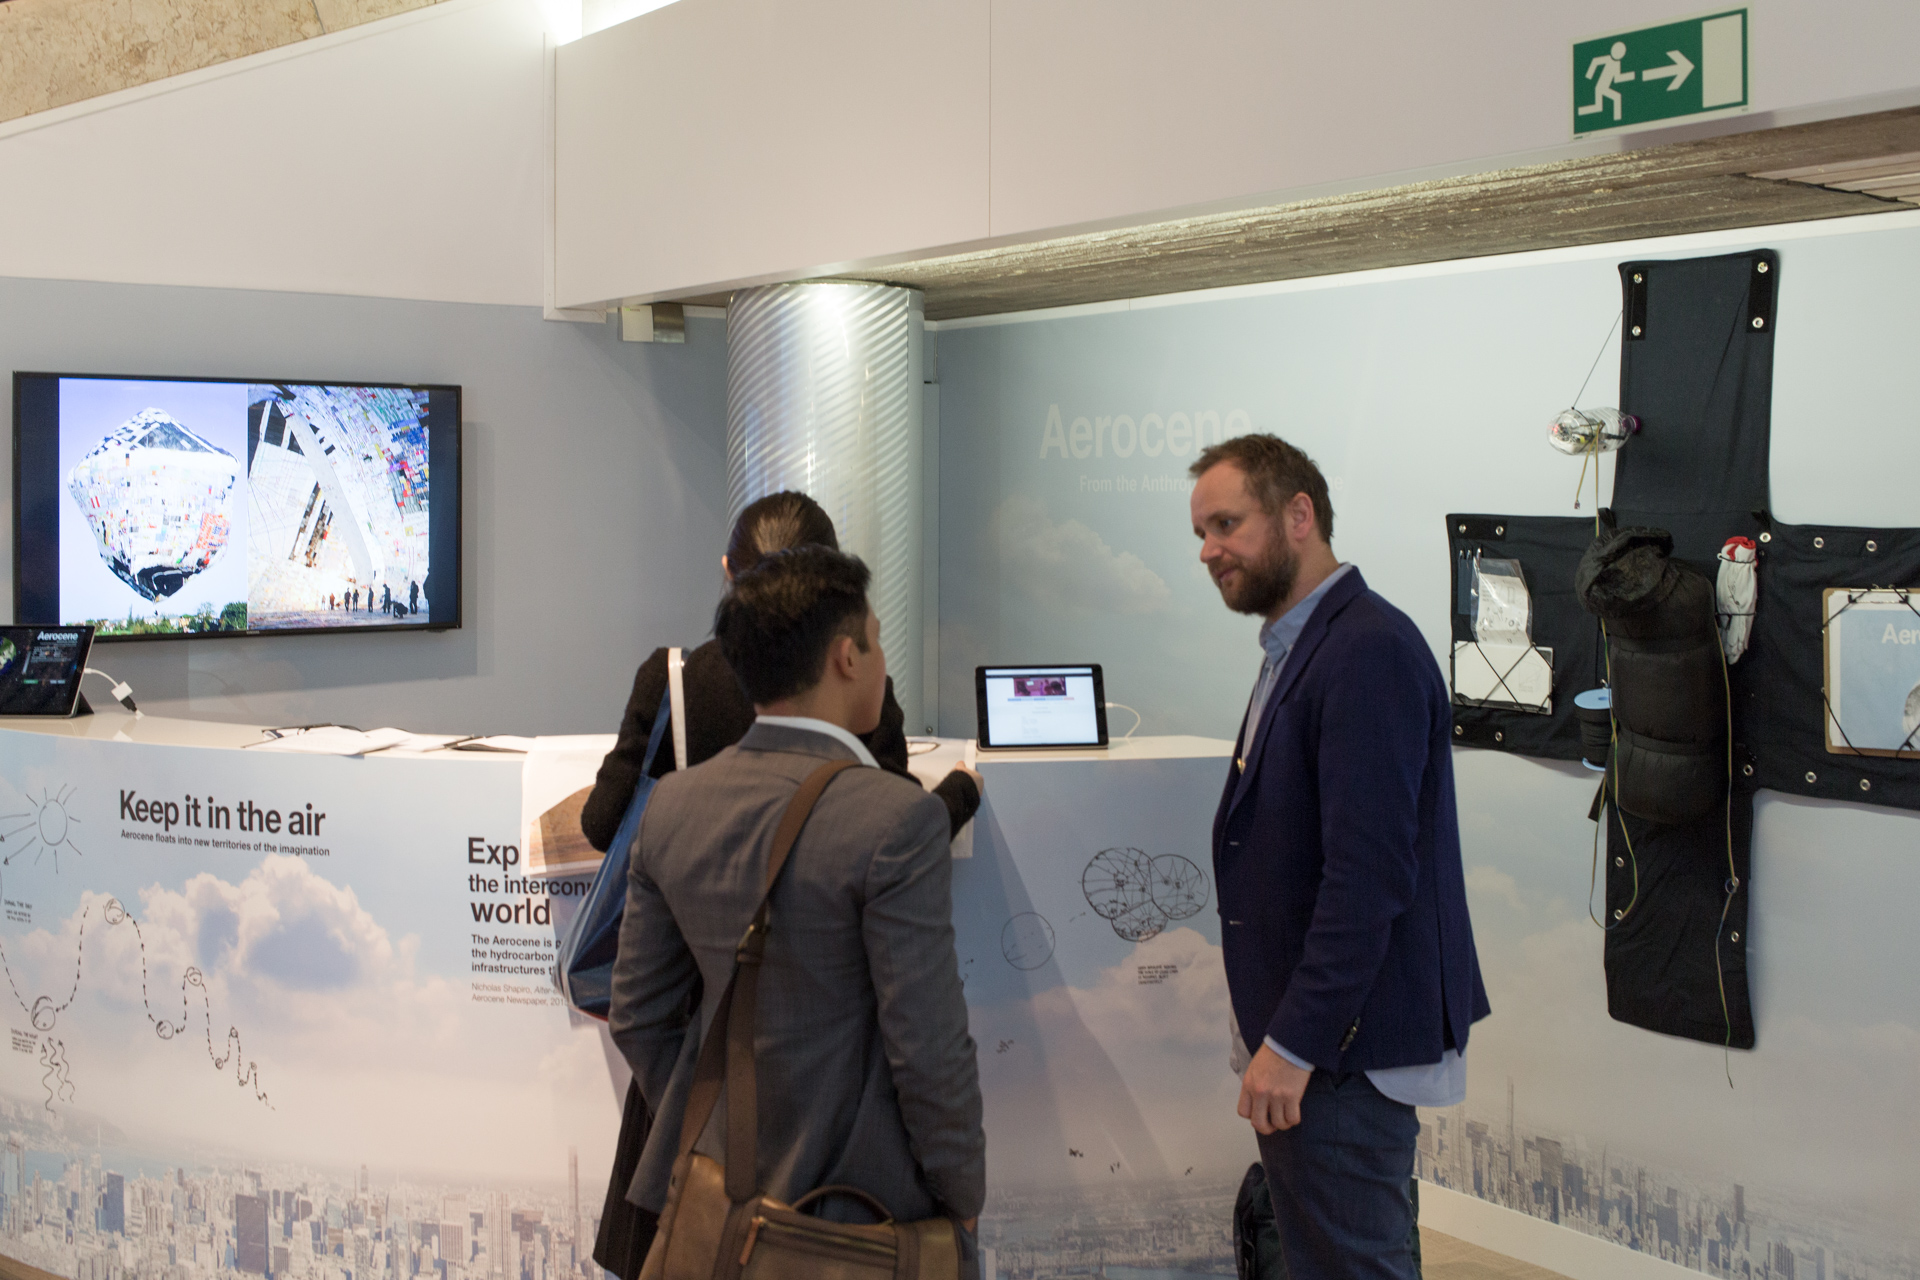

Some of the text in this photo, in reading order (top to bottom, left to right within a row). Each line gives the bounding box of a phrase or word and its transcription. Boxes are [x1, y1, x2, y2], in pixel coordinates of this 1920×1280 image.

[1039, 403, 1251, 459] Aerocene
[1080, 474, 1199, 495] From the Anthrop
[37, 631, 79, 641] Aerocene
[1881, 623, 1920, 645] Aer
[120, 789, 326, 836] Keep it in the air
[121, 829, 330, 857] Aerocene floats into new territories of the imagination
[468, 837, 520, 872] Exp
[468, 874, 593, 896] the intercon
[470, 898, 551, 925] world
[471, 934, 490, 945] The
[493, 935, 540, 947] Aerocene
[543, 937, 552, 948] is
[471, 948, 554, 961] the hydrocarbon
[471, 962, 546, 975] infrastructures
[471, 982, 501, 992] Nicholas
[503, 984, 532, 995] Shapiro,
[472, 993, 505, 1003] Aerocene
[507, 995, 549, 1006] Newspaper,
